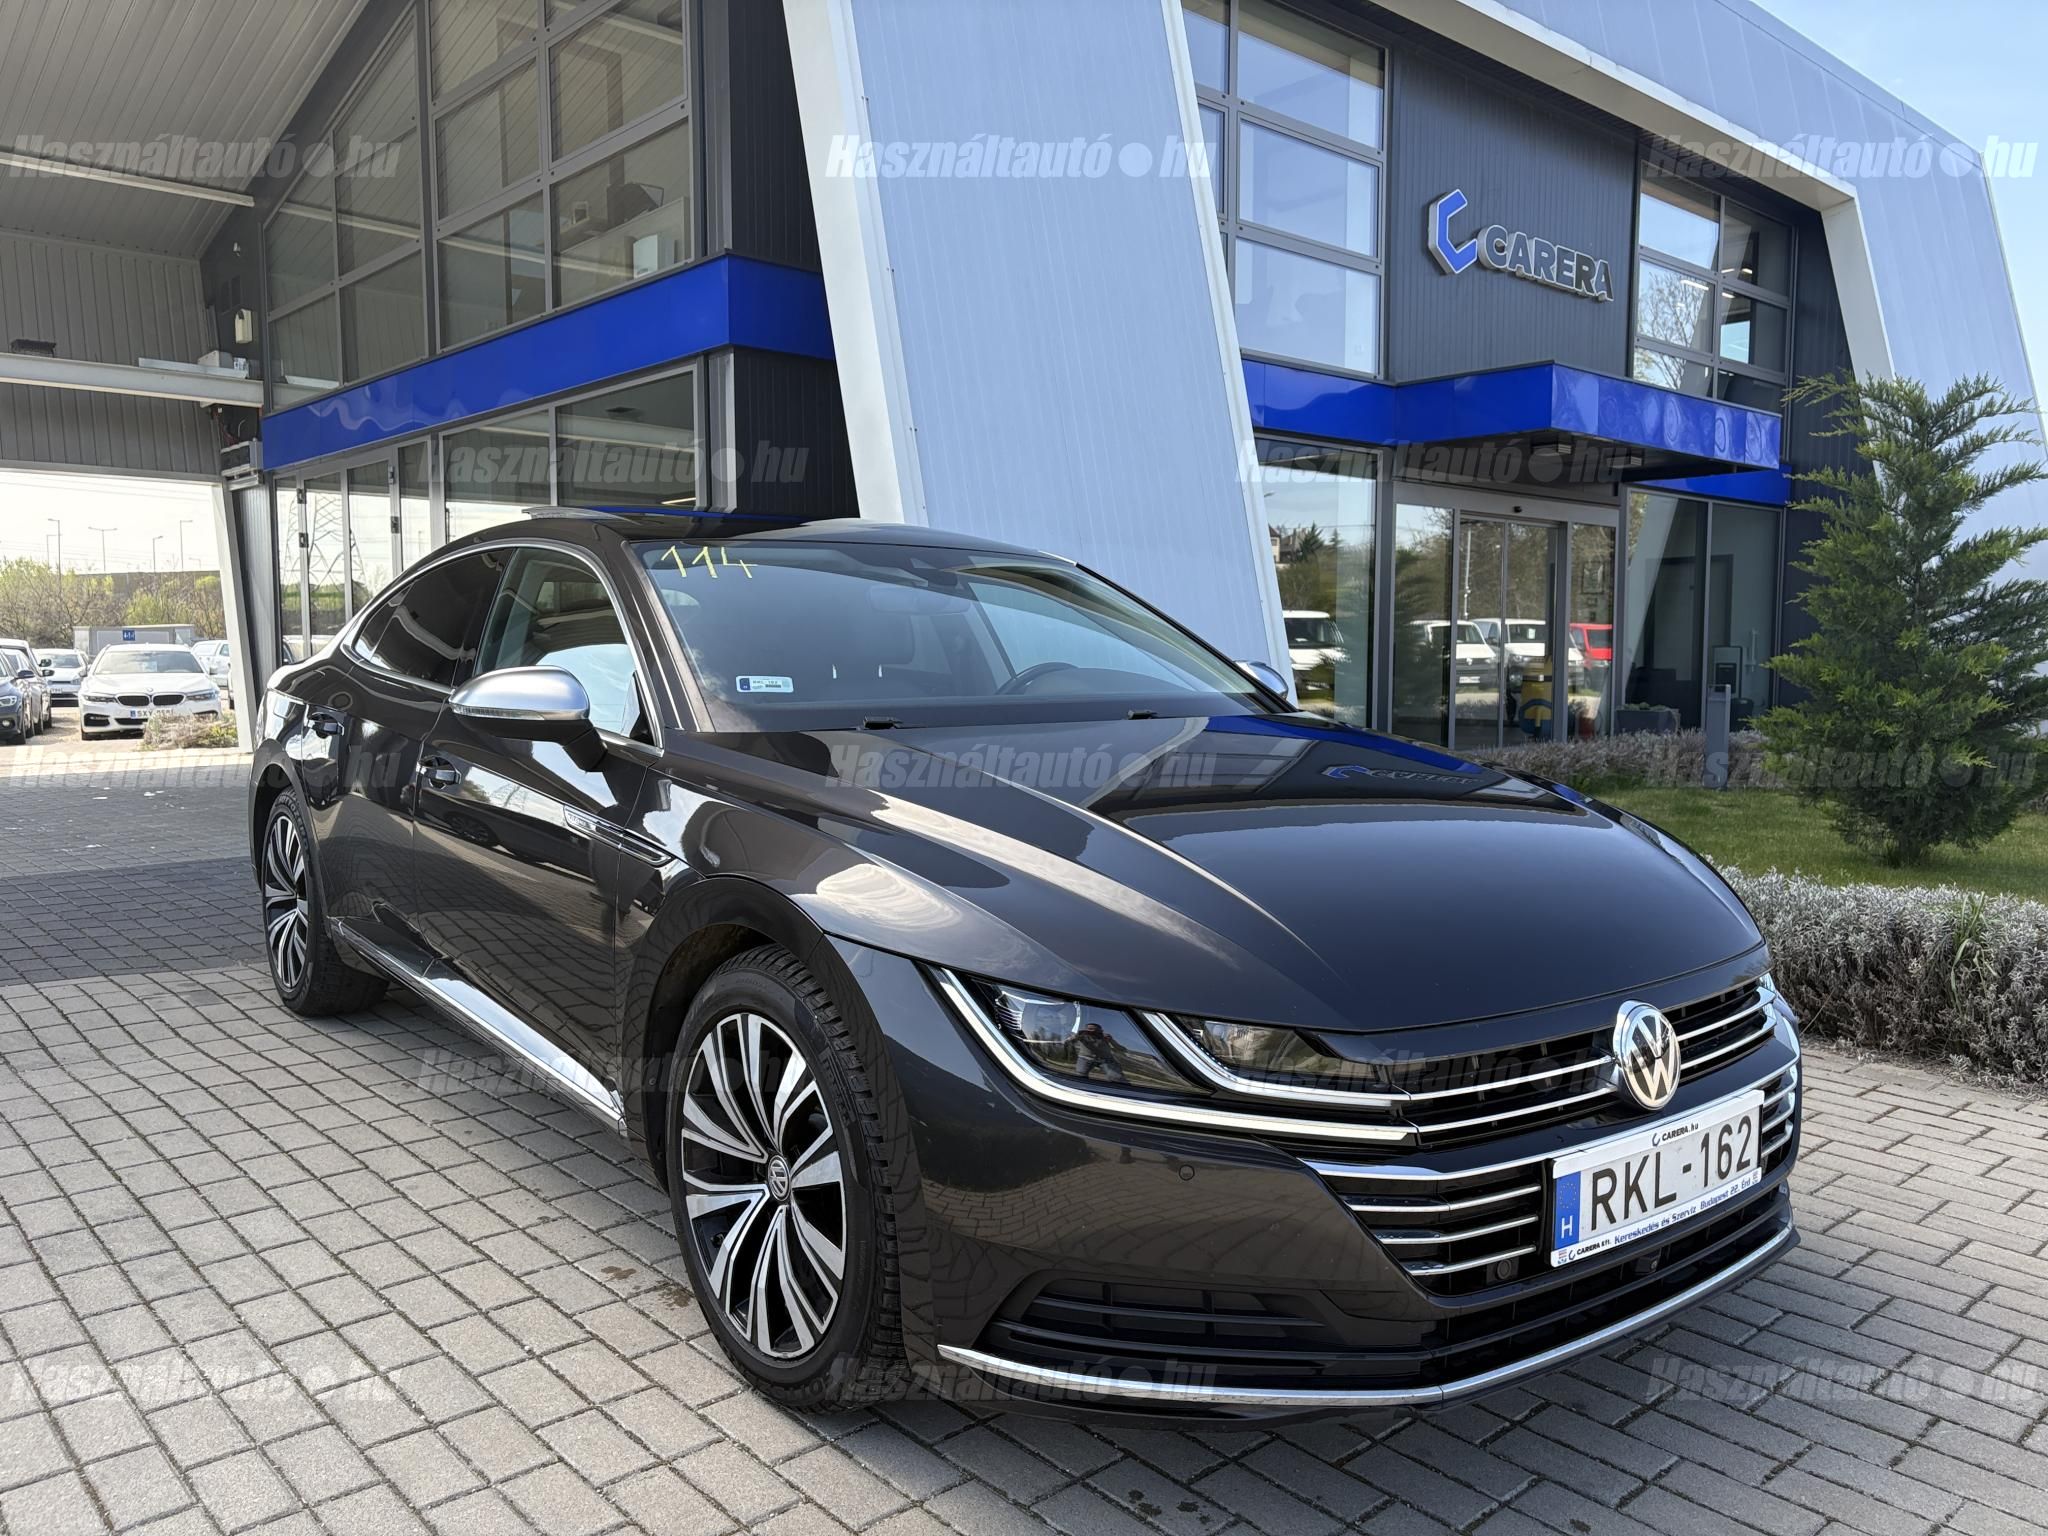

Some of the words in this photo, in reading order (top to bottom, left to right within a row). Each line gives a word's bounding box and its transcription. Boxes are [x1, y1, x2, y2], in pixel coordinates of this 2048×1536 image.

[1477, 224, 1614, 302] CARERA
[661, 545, 758, 579] 114
[1560, 1215, 1573, 1239] H
[1590, 1115, 1752, 1231] RKL-162
[1576, 1242, 1600, 1255] CARERA
